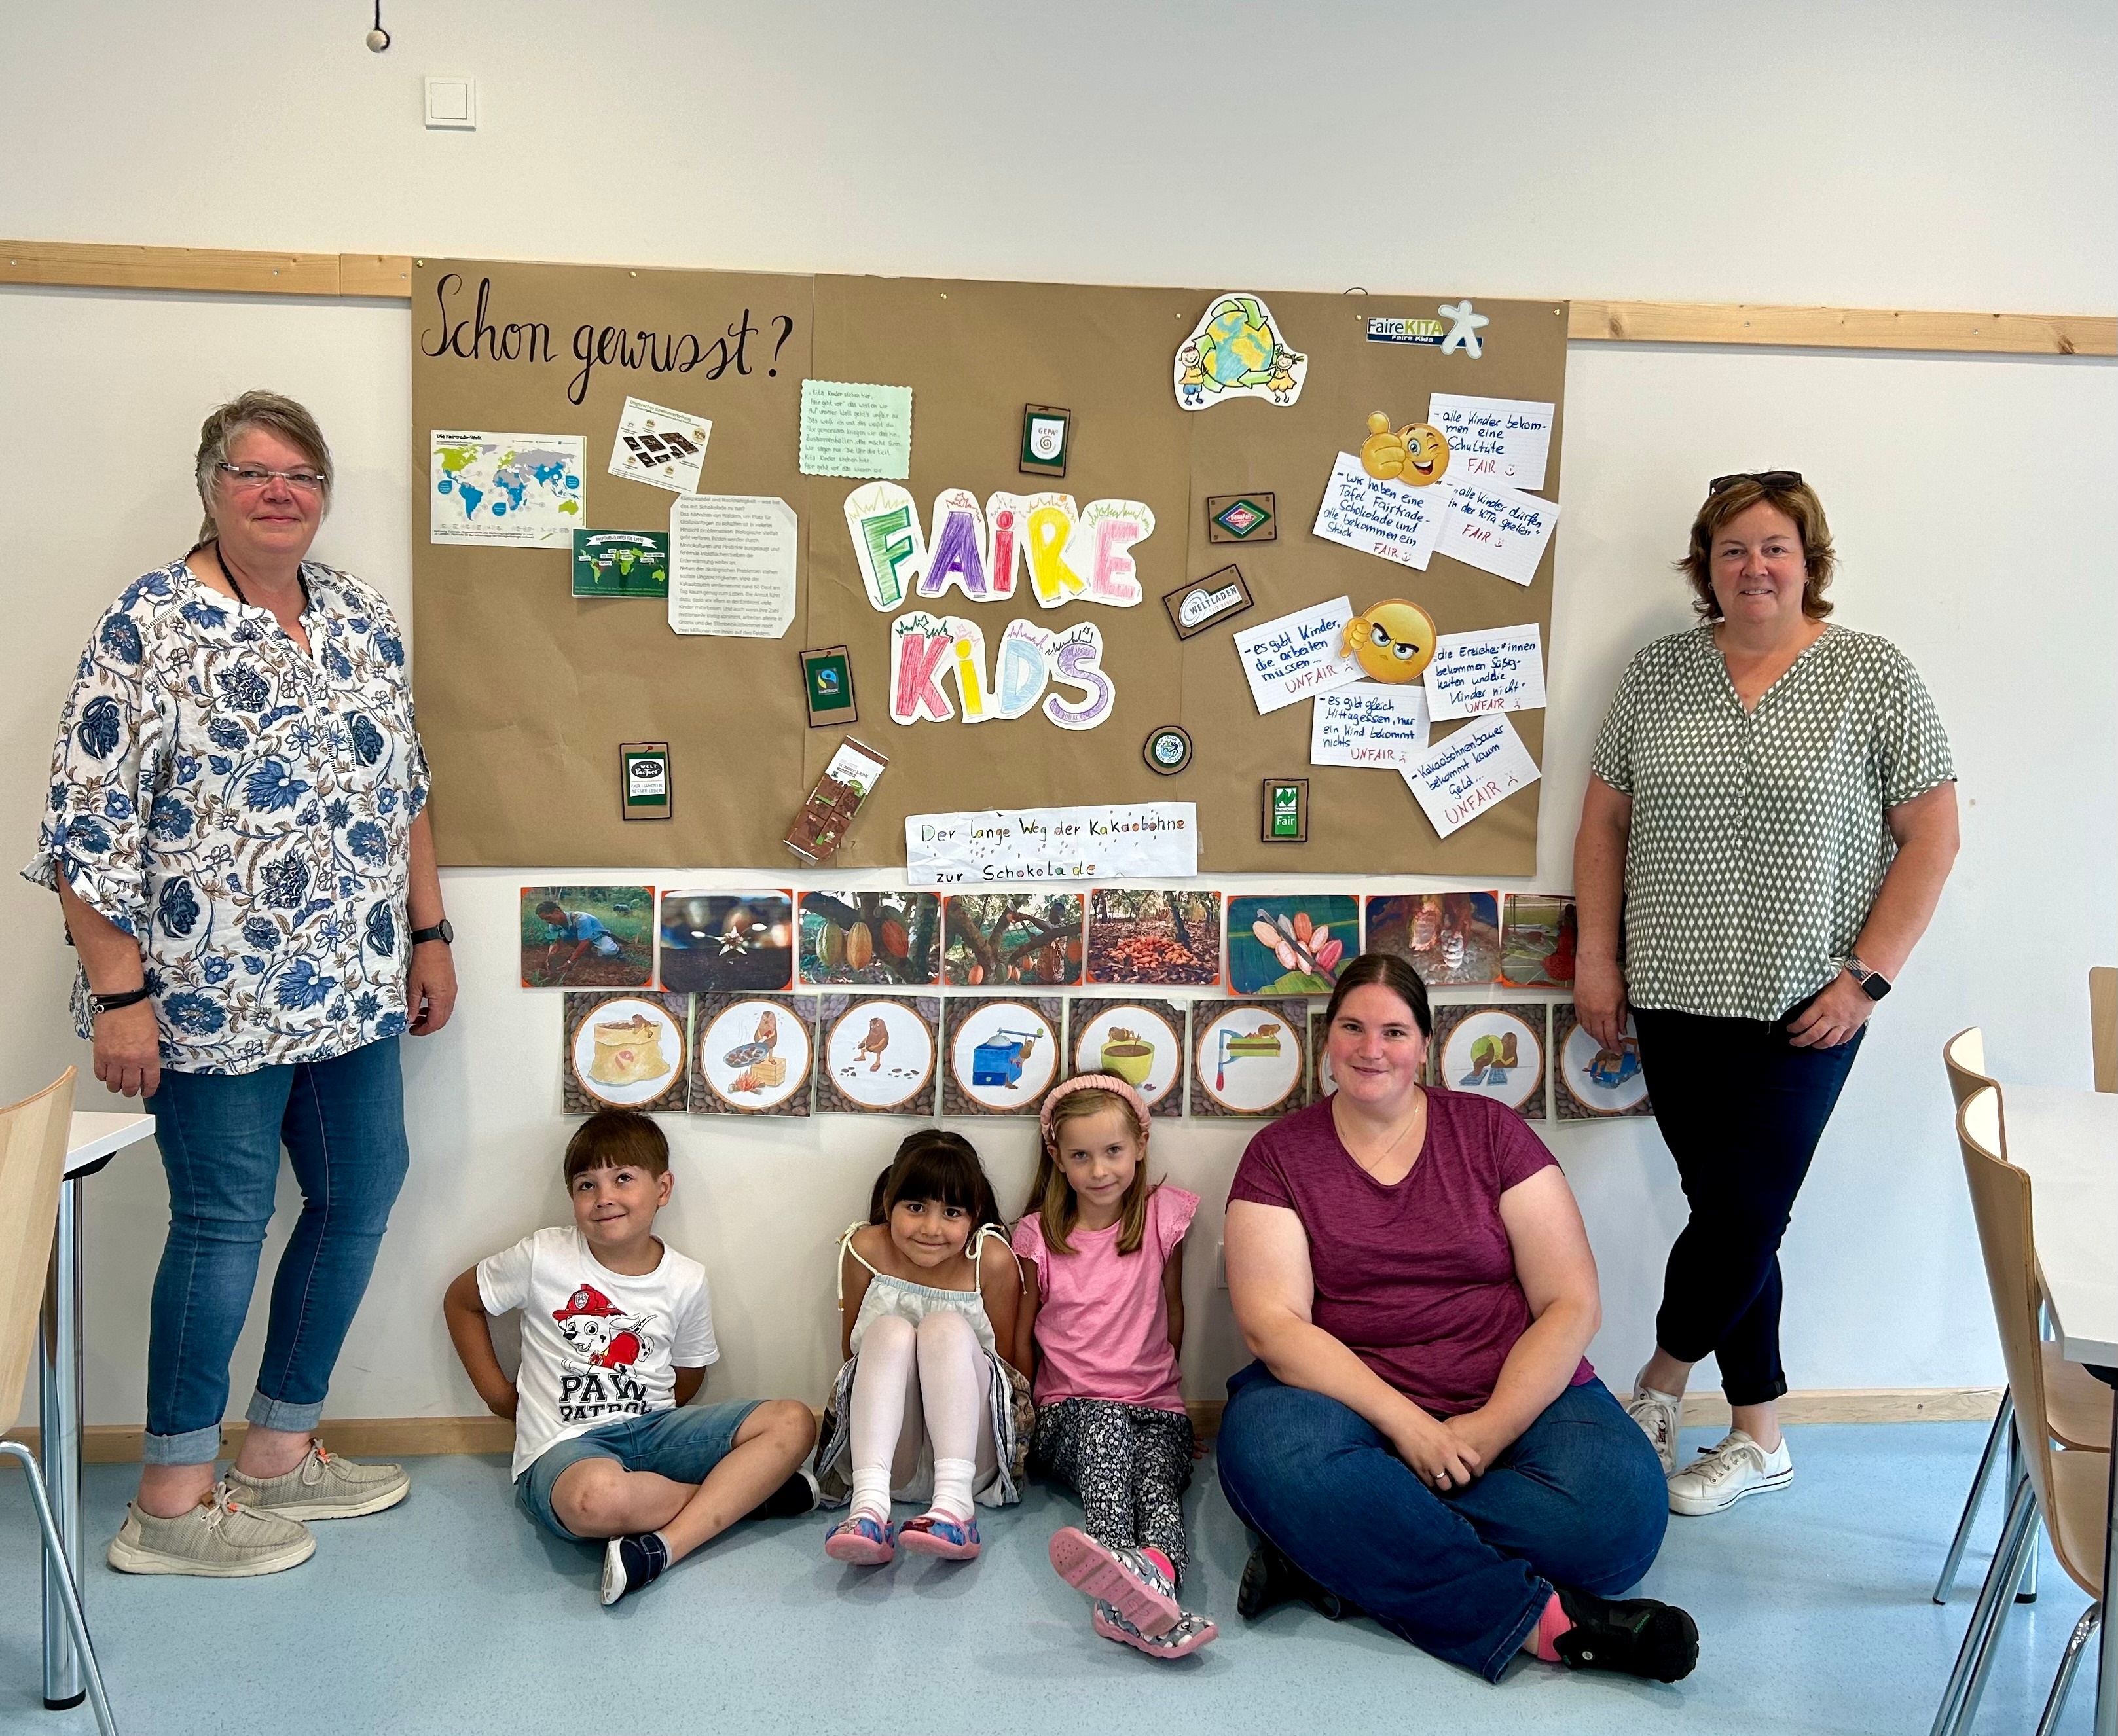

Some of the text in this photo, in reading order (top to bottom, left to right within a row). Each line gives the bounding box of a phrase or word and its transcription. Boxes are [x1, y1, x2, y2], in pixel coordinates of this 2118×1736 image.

[421, 274, 558, 362] Schon
[1368, 319, 1442, 335] FaireKITA
[1469, 411, 1501, 427] Kinder
[1446, 425, 1504, 439] men eine
[1448, 436, 1505, 454] Schultüte
[1468, 458, 1495, 474] FAIR
[1340, 485, 1366, 501] Tafel
[1368, 478, 1396, 499] haben
[1401, 494, 1423, 508] eine
[1340, 500, 1418, 533] Schokolade und
[1461, 504, 1475, 515] der
[1477, 492, 1507, 512] Kinder
[1509, 507, 1541, 528] dürfen
[1326, 522, 1353, 537] Stück
[1344, 514, 1397, 541] bekommen
[1399, 535, 1416, 546] ein
[1462, 524, 1491, 543] FAIR
[1374, 543, 1398, 558] FAIR
[1189, 587, 1237, 615] WELTLADEN
[1269, 632, 1292, 653] gibt
[1256, 640, 1328, 672] die arbeiten
[1285, 665, 1338, 693] UNFAIR
[1436, 664, 1485, 676] bekommen
[1450, 687, 1486, 704] Kinder
[1344, 696, 1362, 711] gibt
[1366, 698, 1393, 714] gleich
[1465, 699, 1504, 713] UNFAIR
[1324, 725, 1415, 739] ein Kind bekommt
[1323, 736, 1350, 748] nichts
[1351, 748, 1395, 761] UNFAIR
[1417, 725, 1503, 778] Kakaobohnenbauer
[1426, 744, 1499, 790] bekommt kaum
[1445, 781, 1501, 824] UNFAIR
[1277, 816, 1294, 825] Fair
[922, 825, 955, 842] Der
[1019, 818, 1046, 844] Weg
[1055, 820, 1080, 836] der
[937, 872, 963, 883] zur
[559, 1373, 648, 1403] PAW
[559, 1400, 652, 1422] PATROL
